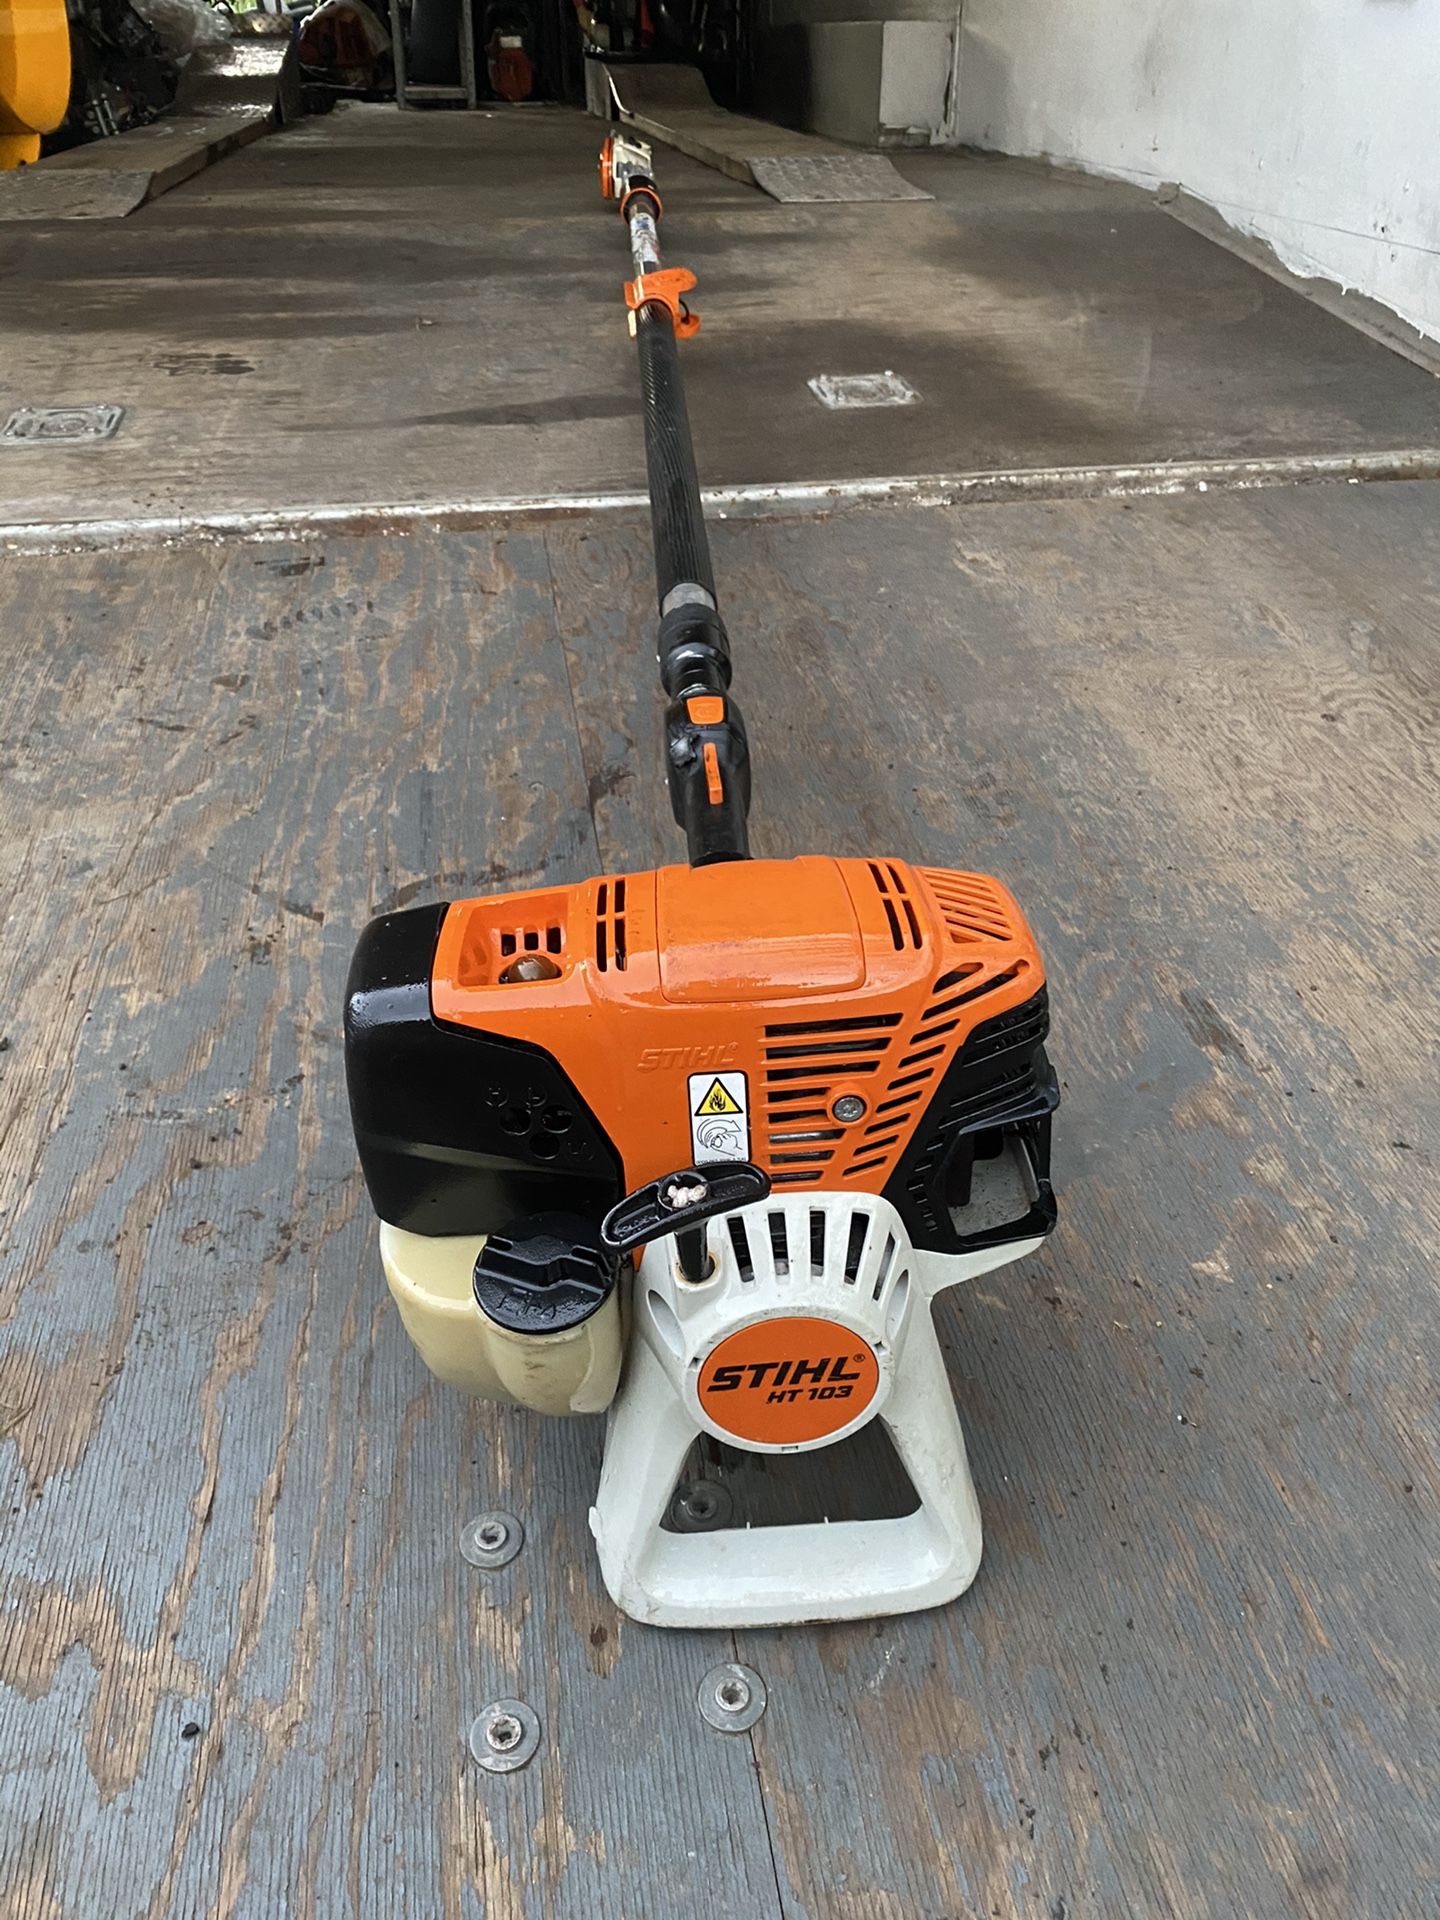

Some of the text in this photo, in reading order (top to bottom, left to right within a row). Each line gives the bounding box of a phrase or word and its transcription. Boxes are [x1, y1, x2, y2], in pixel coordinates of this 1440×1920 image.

[637, 1045, 735, 1073] STIHL
[706, 1356, 861, 1392] STIHL
[767, 1385, 854, 1404] HT 103
